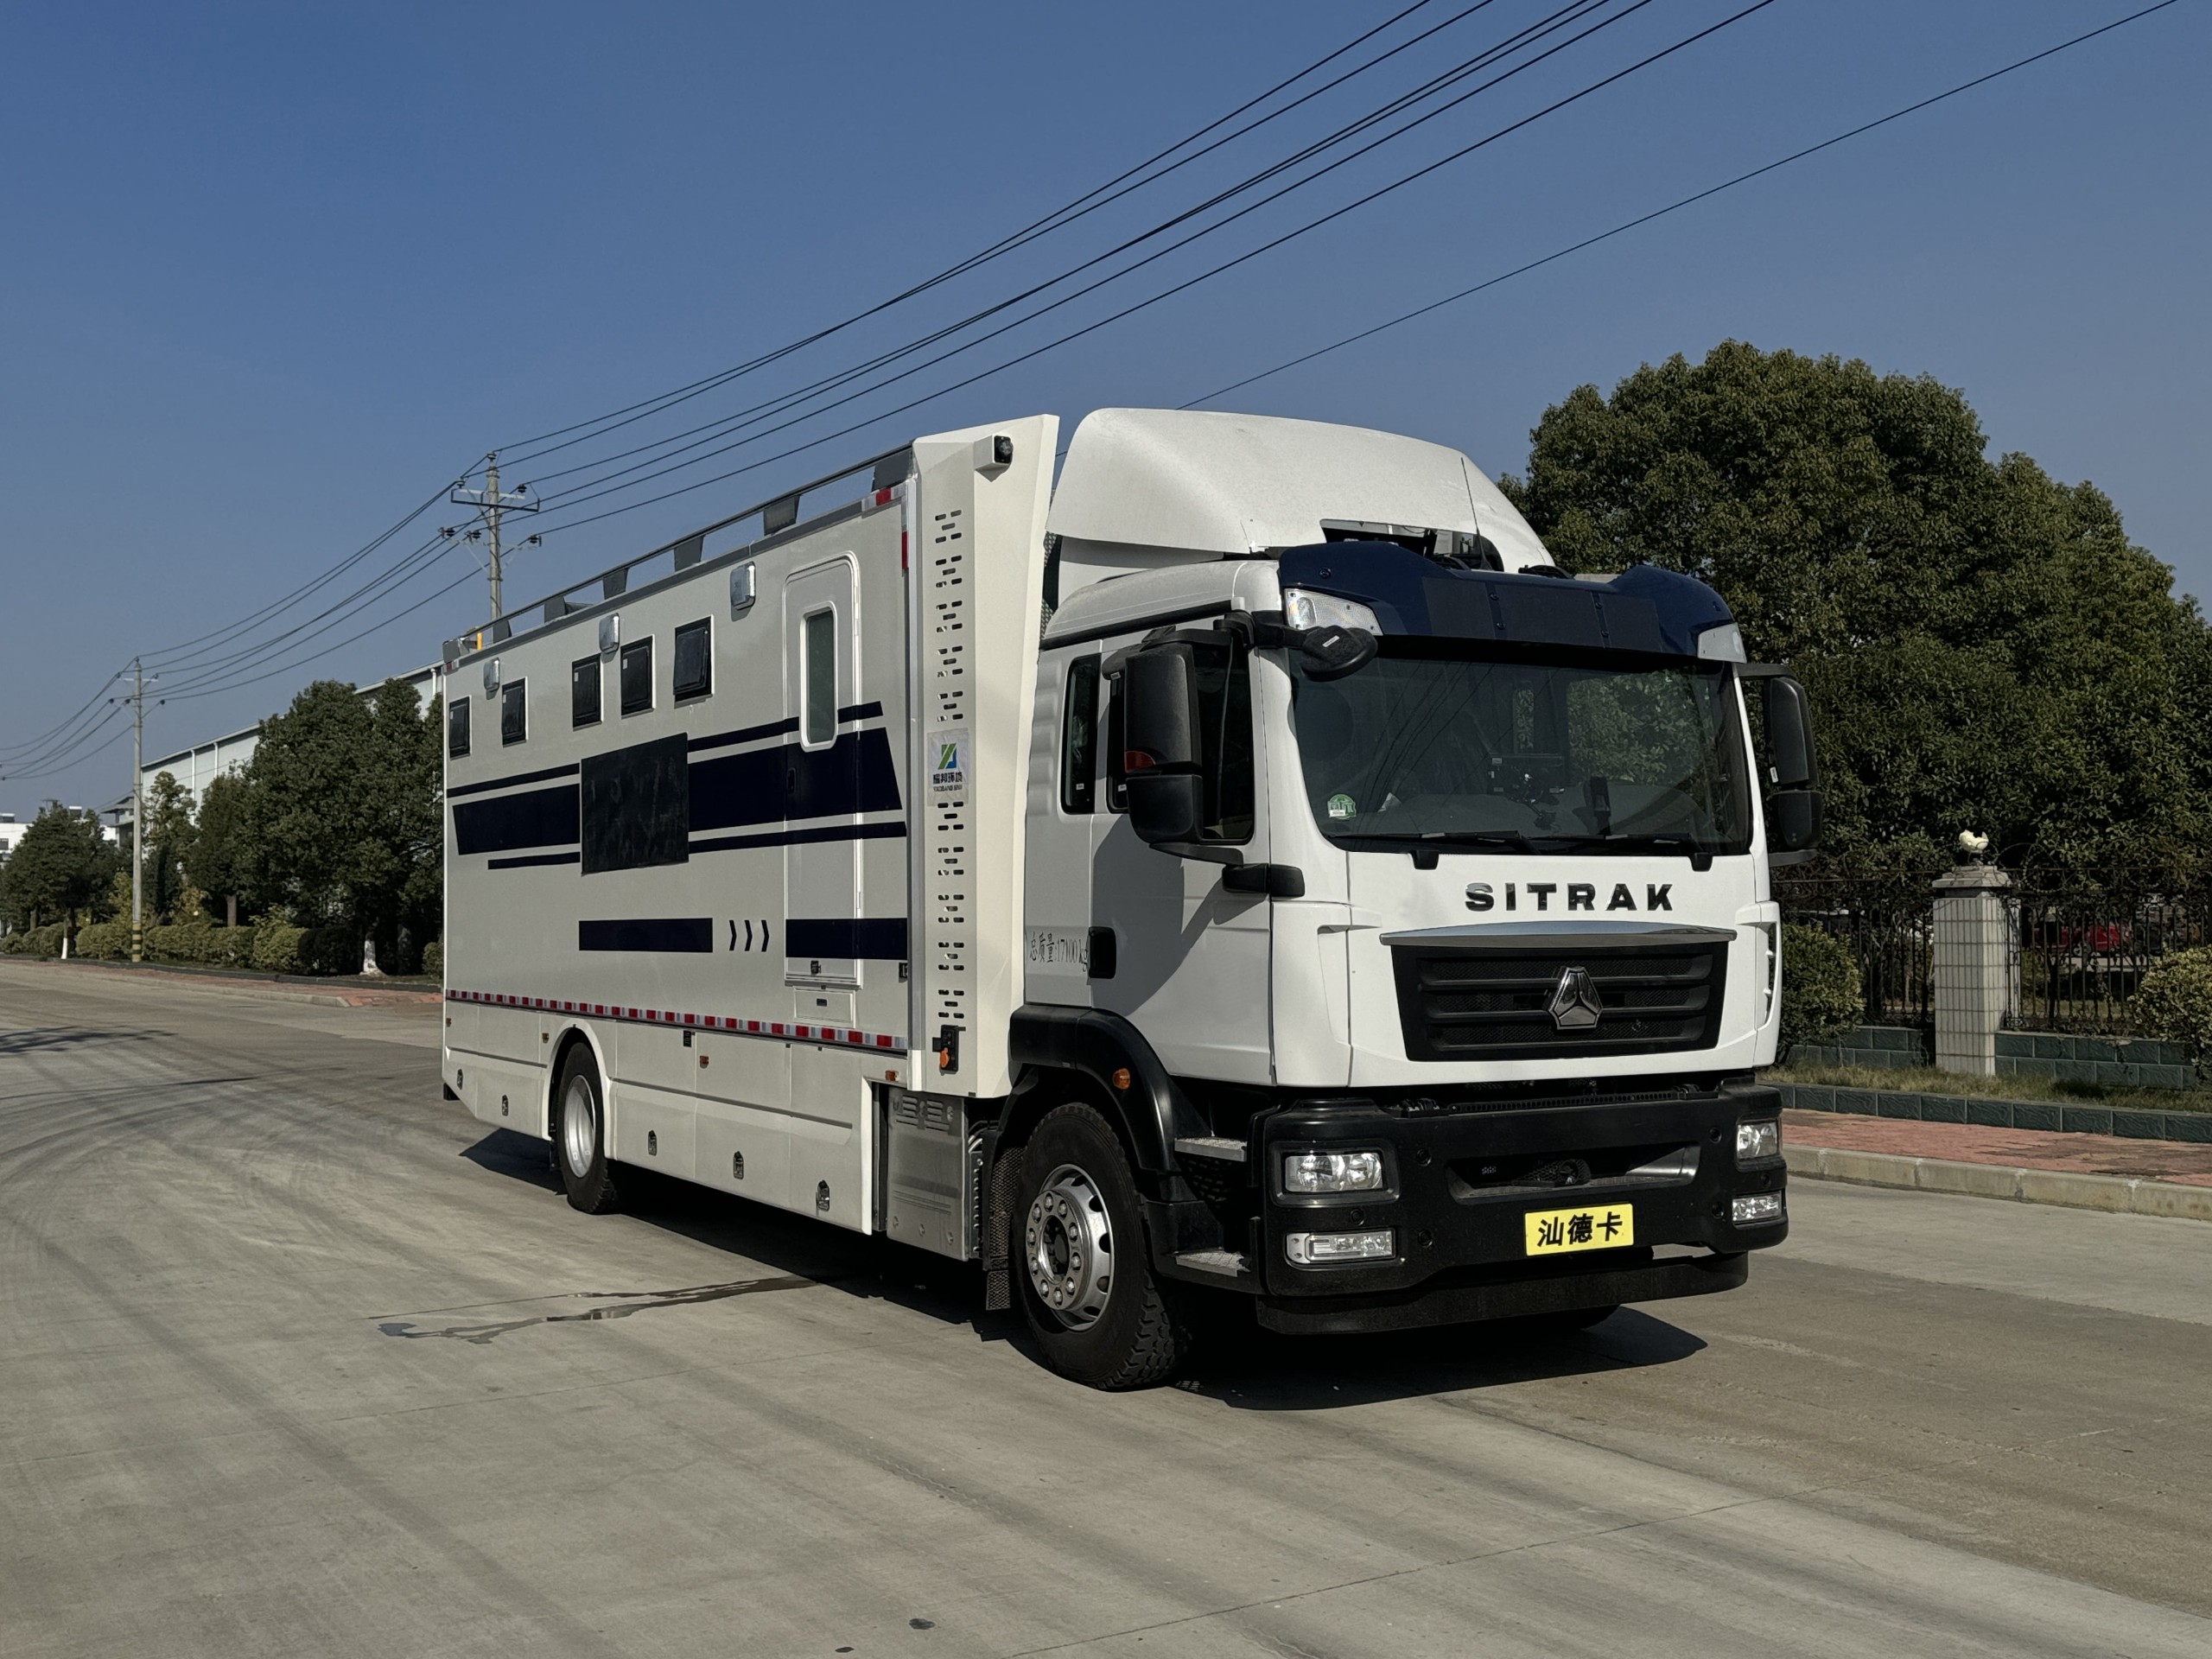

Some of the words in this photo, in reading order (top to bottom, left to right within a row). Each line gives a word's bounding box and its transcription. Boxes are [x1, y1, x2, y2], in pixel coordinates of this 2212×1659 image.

[1465, 882, 1674, 912] SITRAK
[1536, 1211, 1623, 1248] 汕德卡
